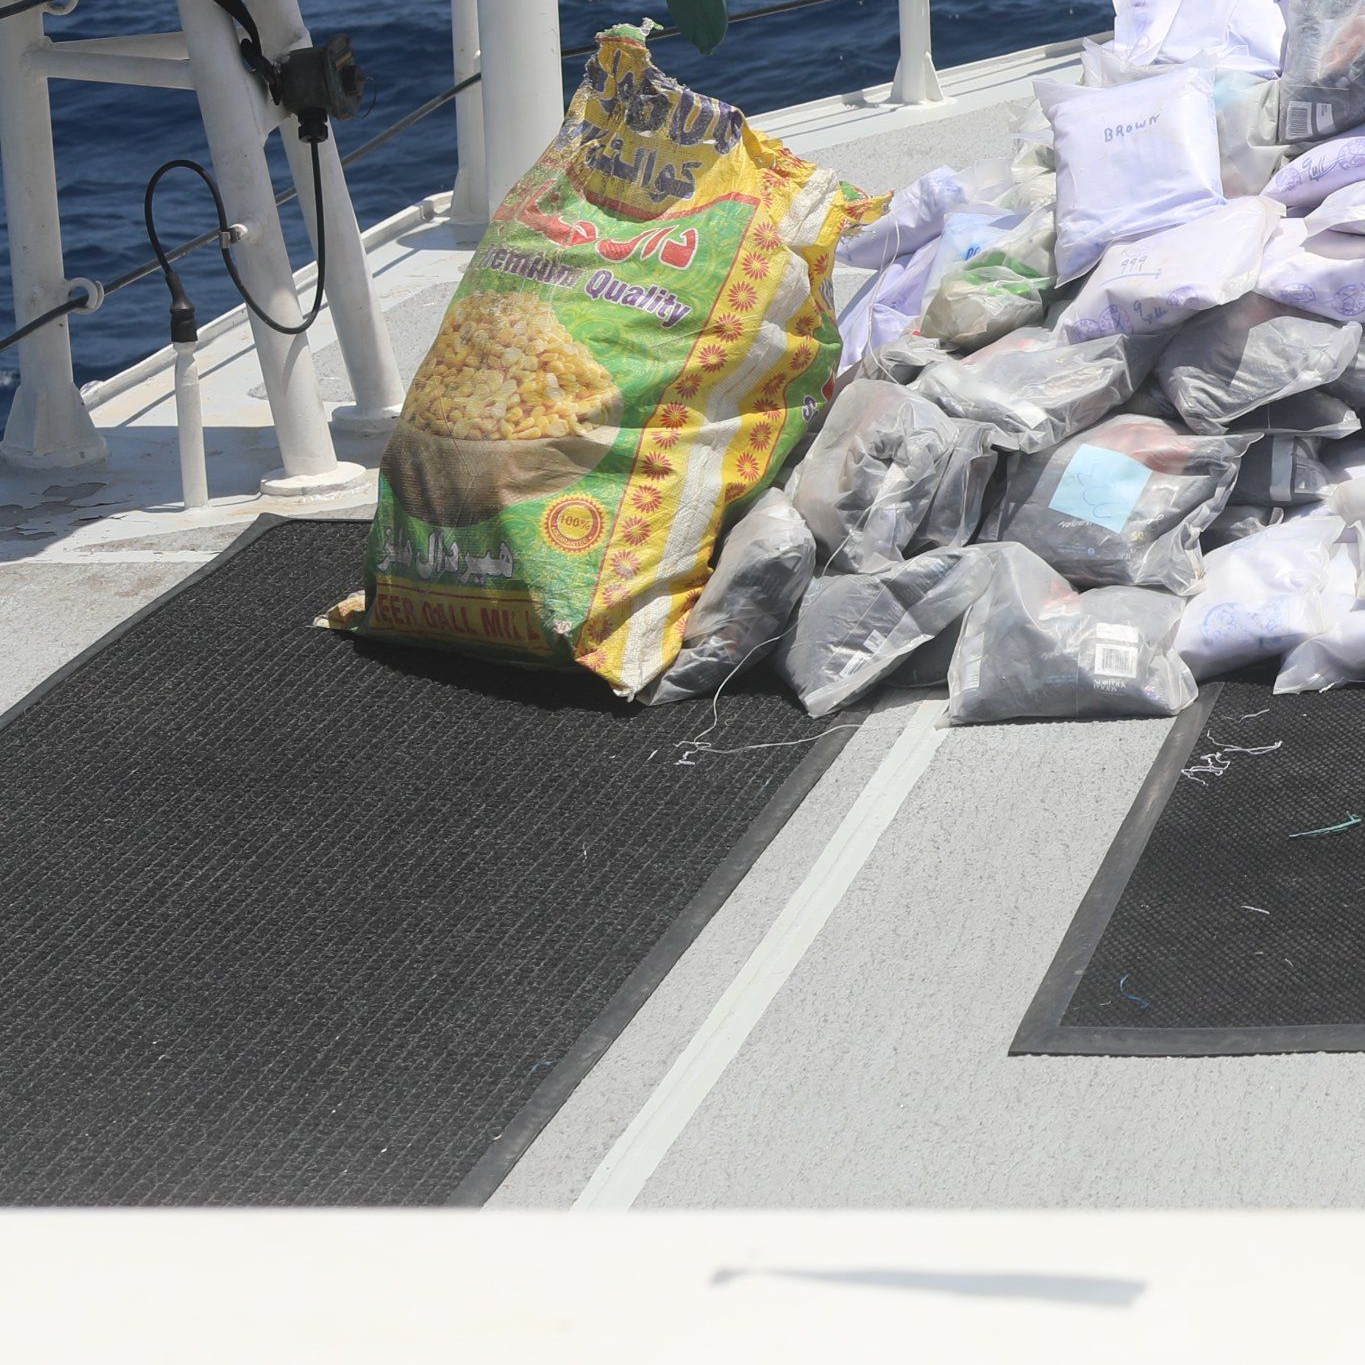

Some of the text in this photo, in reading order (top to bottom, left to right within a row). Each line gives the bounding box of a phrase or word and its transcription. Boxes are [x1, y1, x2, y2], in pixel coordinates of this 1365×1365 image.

[1103, 113, 1161, 143] BROWN
[583, 267, 694, 328] Quality
[559, 514, 592, 531] 100%
